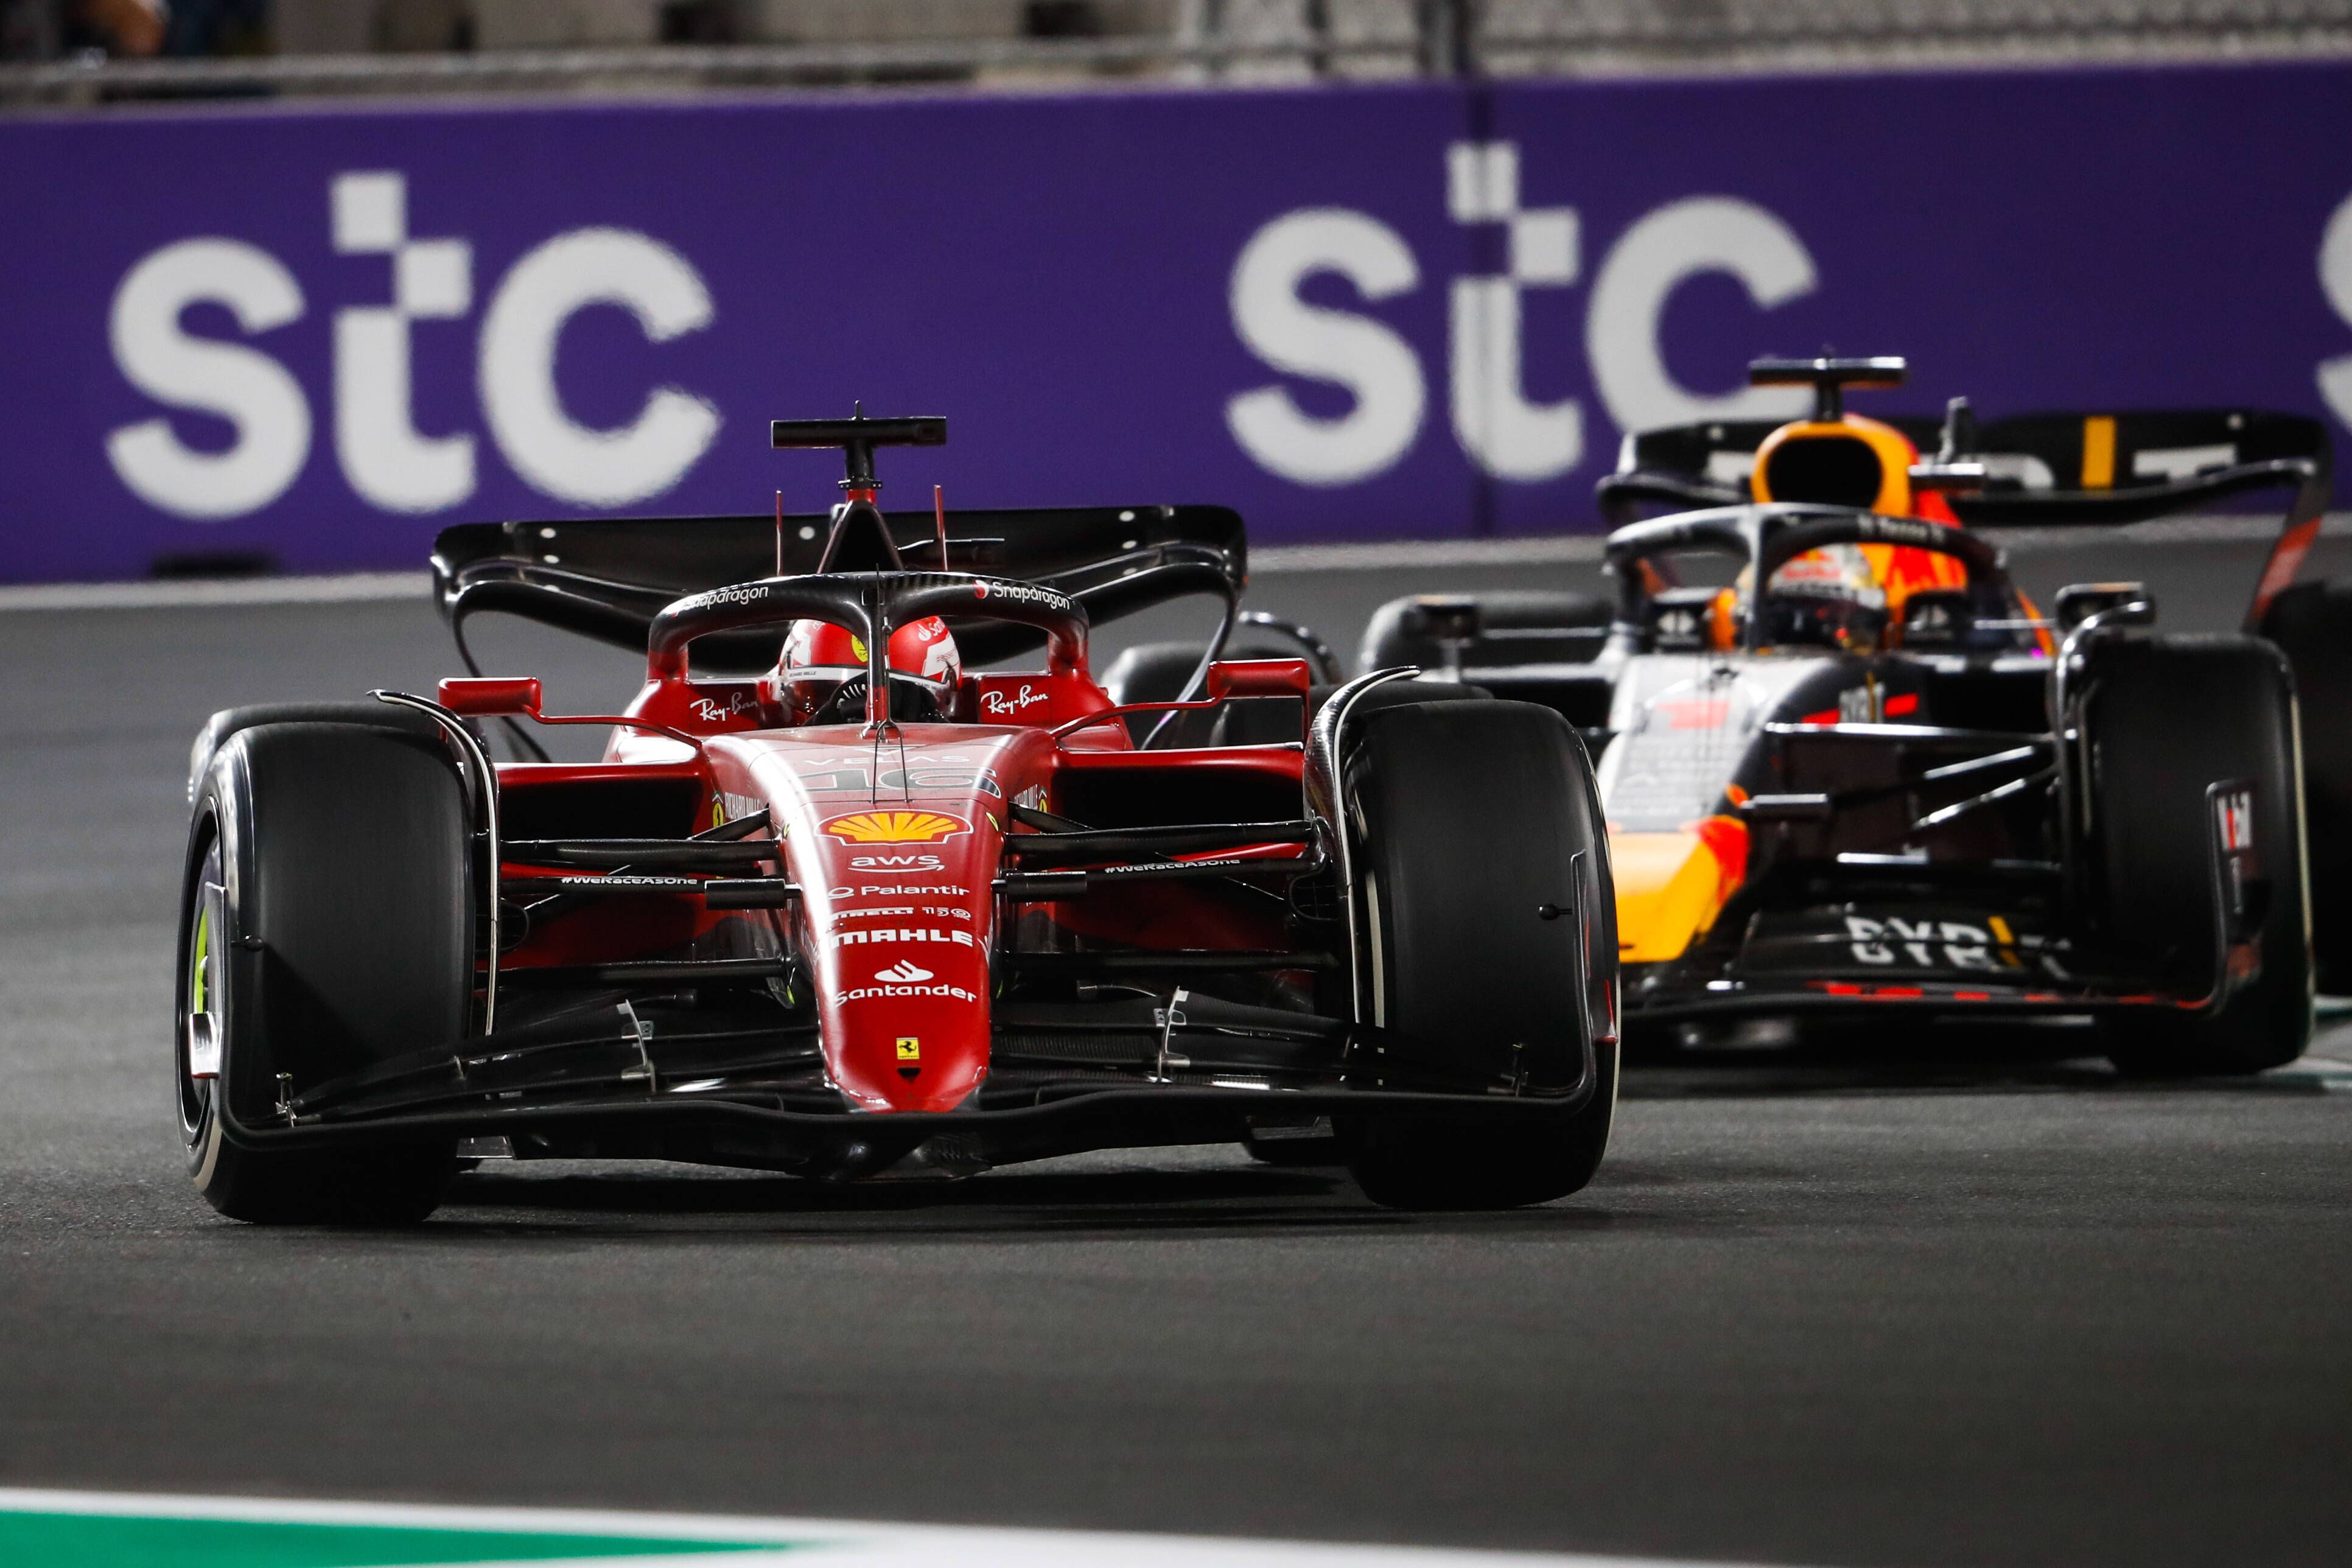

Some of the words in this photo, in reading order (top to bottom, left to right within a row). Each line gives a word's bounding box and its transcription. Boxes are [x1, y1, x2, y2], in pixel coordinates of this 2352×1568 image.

[1226, 141, 1819, 487] stc
[106, 171, 723, 520] stc
[992, 581, 1069, 610] Snapdragon
[690, 692, 758, 721] Ray-Ban
[980, 684, 1048, 715] Ray-Ban
[803, 755, 970, 766] VELAS
[851, 855, 940, 867] aws
[1105, 859, 1241, 873] #WeRaceAsOne
[561, 876, 698, 884] #WeRaceAsOne
[861, 885, 970, 896] Palantir
[830, 929, 973, 949] MAHLE
[834, 984, 976, 1007] Santander
